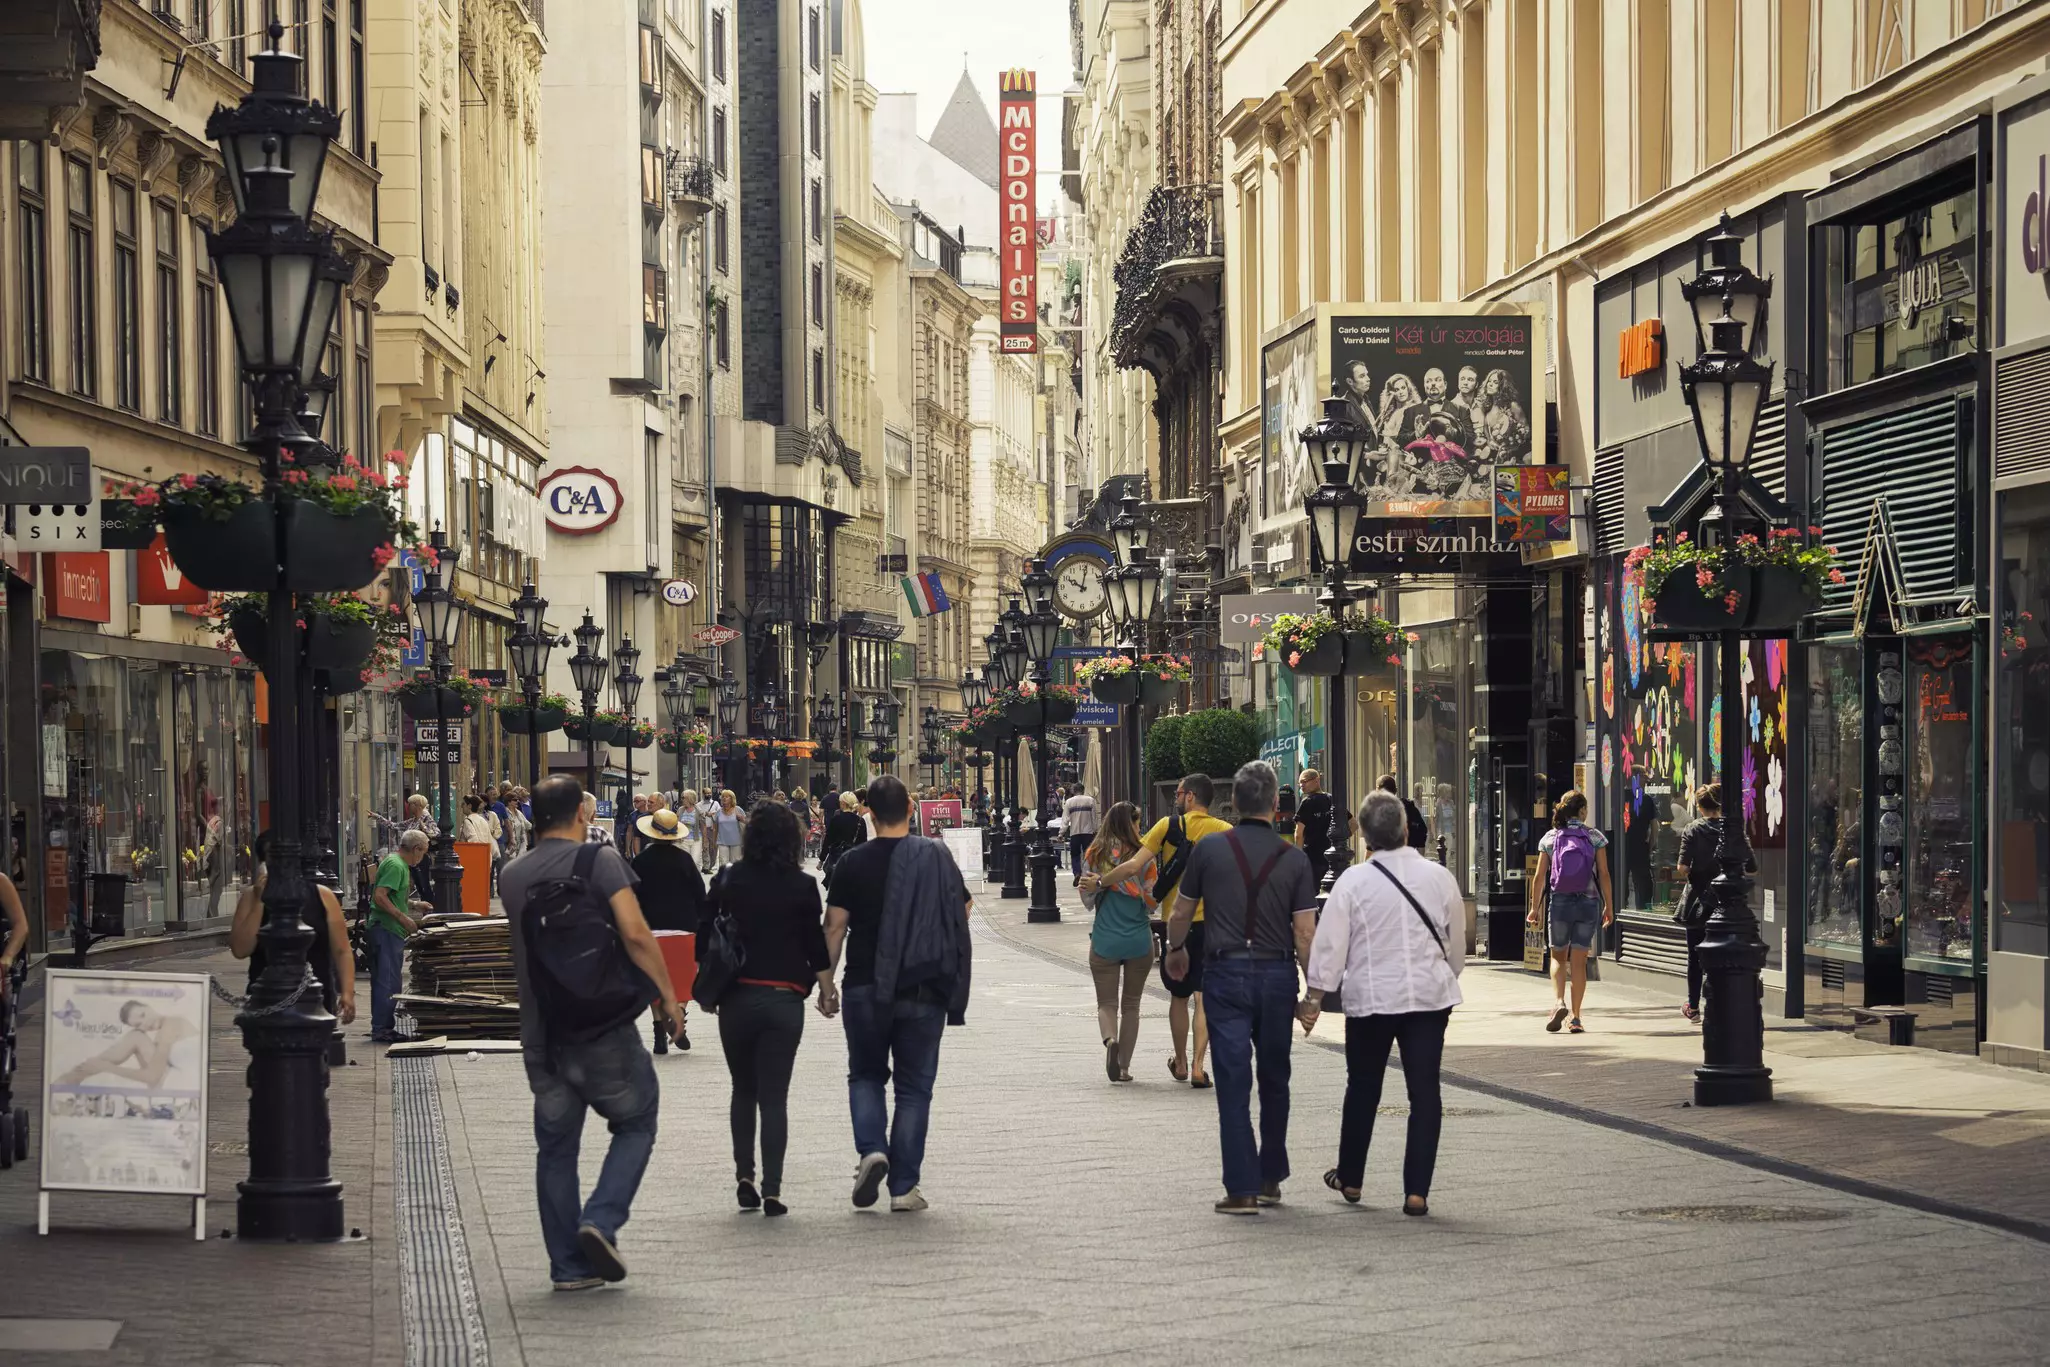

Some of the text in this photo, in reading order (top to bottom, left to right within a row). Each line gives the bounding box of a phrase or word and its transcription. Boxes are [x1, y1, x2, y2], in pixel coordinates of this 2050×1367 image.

[1003, 106, 1034, 321] McDonald's
[1338, 326, 1390, 334] Carlo Goldoni
[1395, 325, 1525, 347] Két úr szolgája
[1343, 336, 1390, 344] Varró Dániel
[550, 485, 607, 515] C&A
[1525, 494, 1565, 507] PYLONES
[30, 526, 87, 539] SIX
[62, 561, 101, 603] inmedio
[666, 586, 689, 600] C&A
[699, 627, 734, 641] Lee Cooper
[421, 729, 457, 740] CHAGE
[418, 751, 459, 762] MASGE
